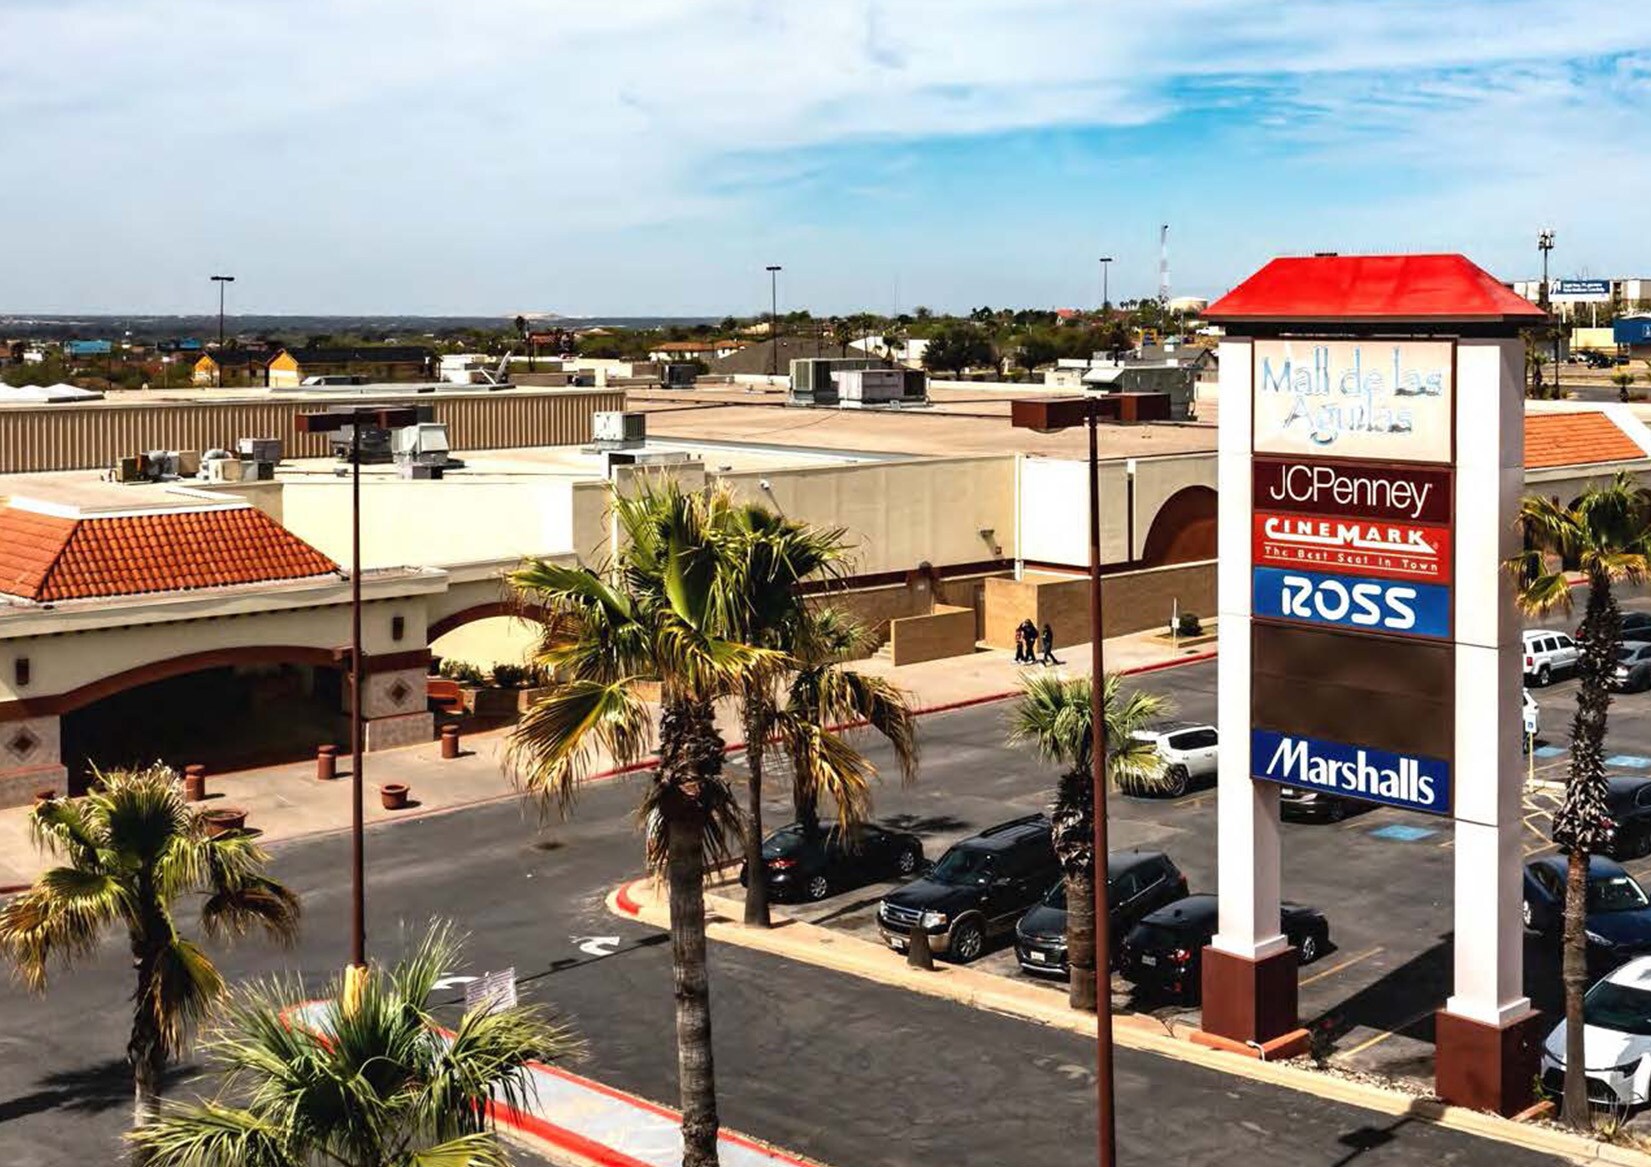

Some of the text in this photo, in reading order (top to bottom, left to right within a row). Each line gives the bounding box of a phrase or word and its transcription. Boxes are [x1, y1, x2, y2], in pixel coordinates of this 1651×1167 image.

[1263, 346, 1329, 395] Mall
[1340, 346, 1383, 396] de
[1270, 465, 1430, 518] JCPenney
[1264, 546, 1288, 556] The
[1298, 550, 1328, 561] Best
[1337, 553, 1368, 565] Seat
[1402, 559, 1438, 571] Town
[1281, 576, 1417, 629] ROSS
[1266, 737, 1435, 805] Marshalls
